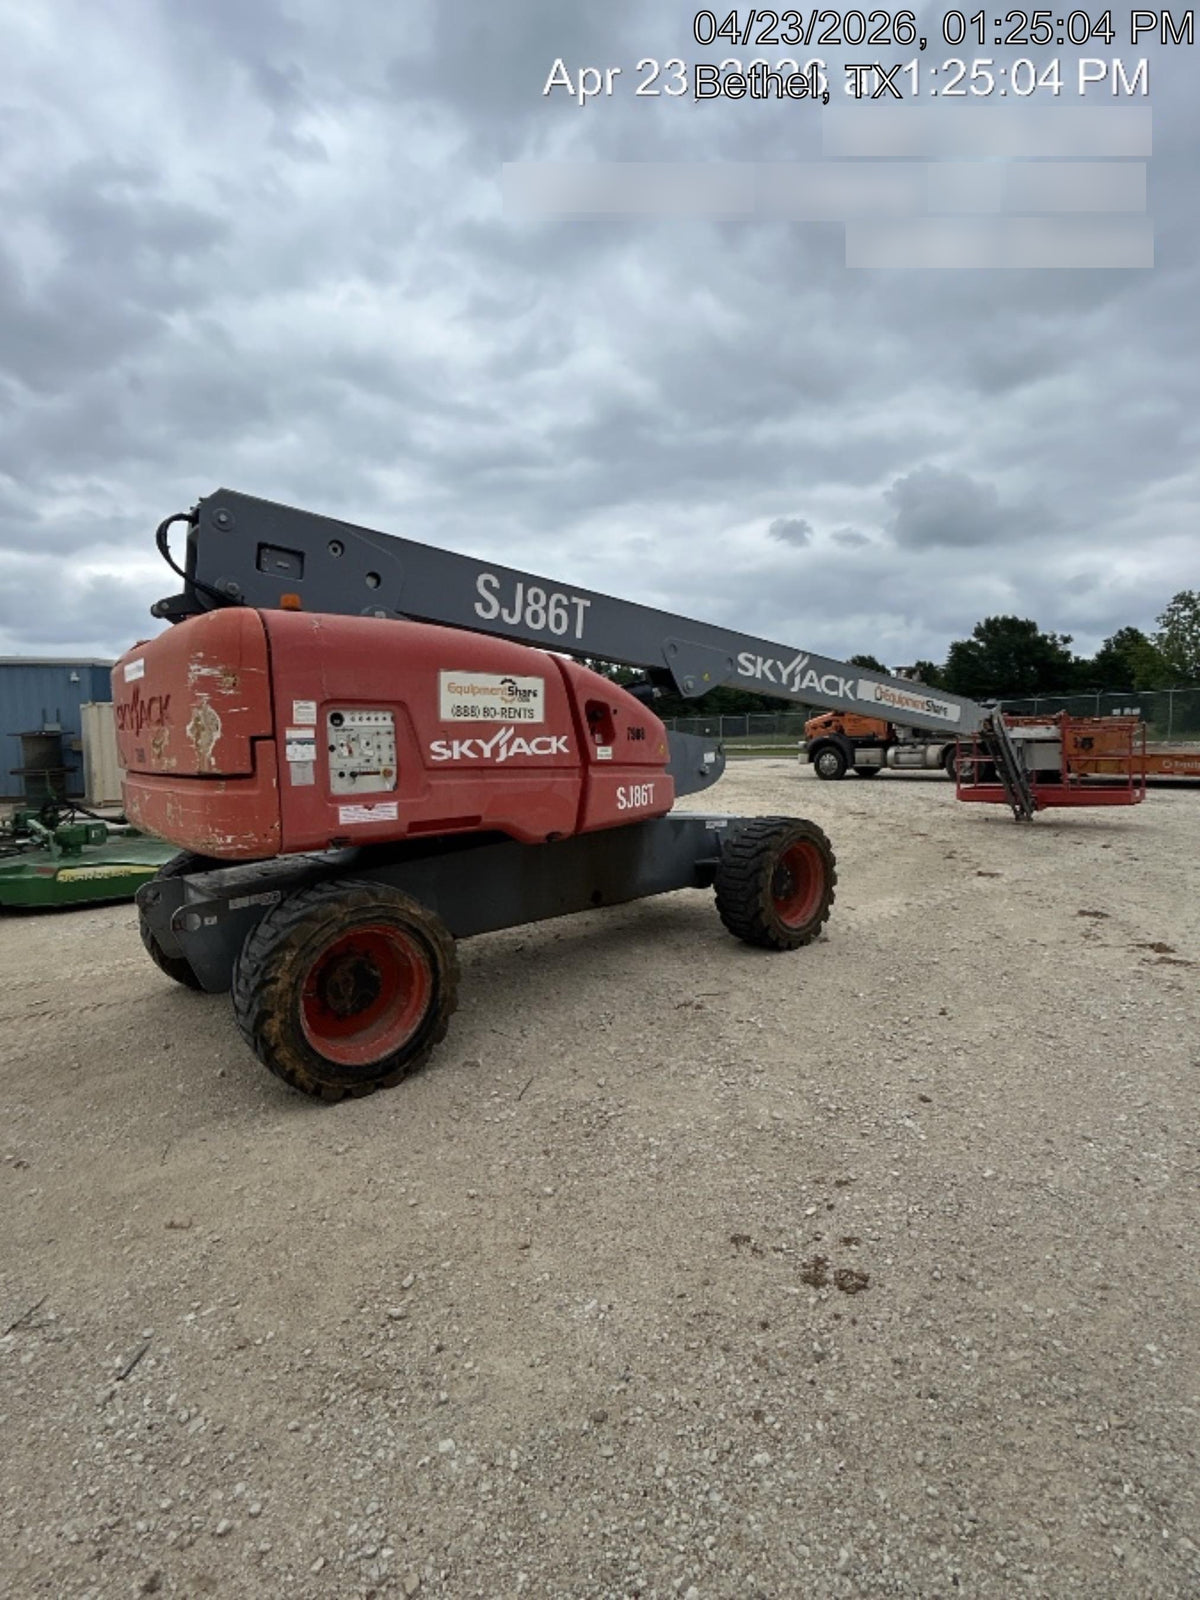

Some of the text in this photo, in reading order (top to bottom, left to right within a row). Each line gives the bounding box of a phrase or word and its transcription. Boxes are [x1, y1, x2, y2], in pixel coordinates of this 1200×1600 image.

[474, 573, 591, 639] SJ86T
[737, 651, 856, 700] SKYJACK
[429, 726, 570, 763] SKYJACK
[616, 783, 655, 810] SJ86T
